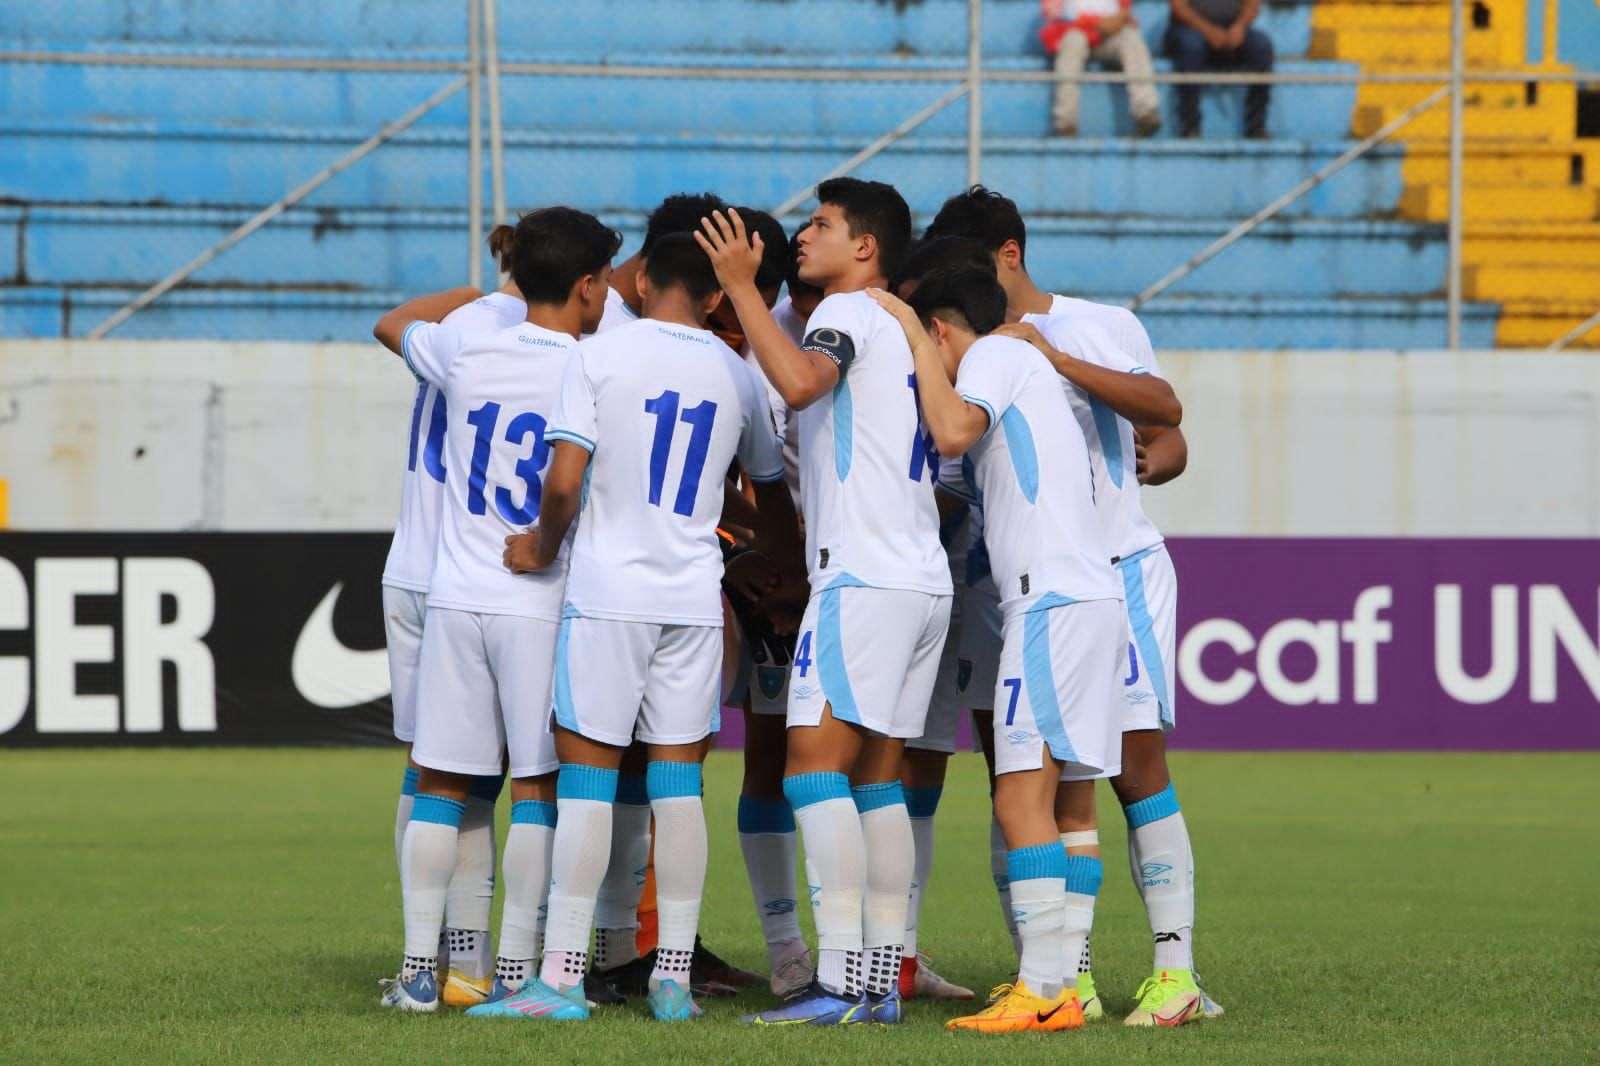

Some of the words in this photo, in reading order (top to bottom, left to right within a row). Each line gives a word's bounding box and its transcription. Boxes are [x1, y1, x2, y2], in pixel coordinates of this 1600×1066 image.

[518, 335, 568, 349] GUATEMALA
[658, 326, 711, 345] GUATEMALA
[468, 400, 551, 526] 13
[645, 389, 718, 517] 11
[907, 372, 939, 484] 1
[1003, 678, 1022, 726] 7
